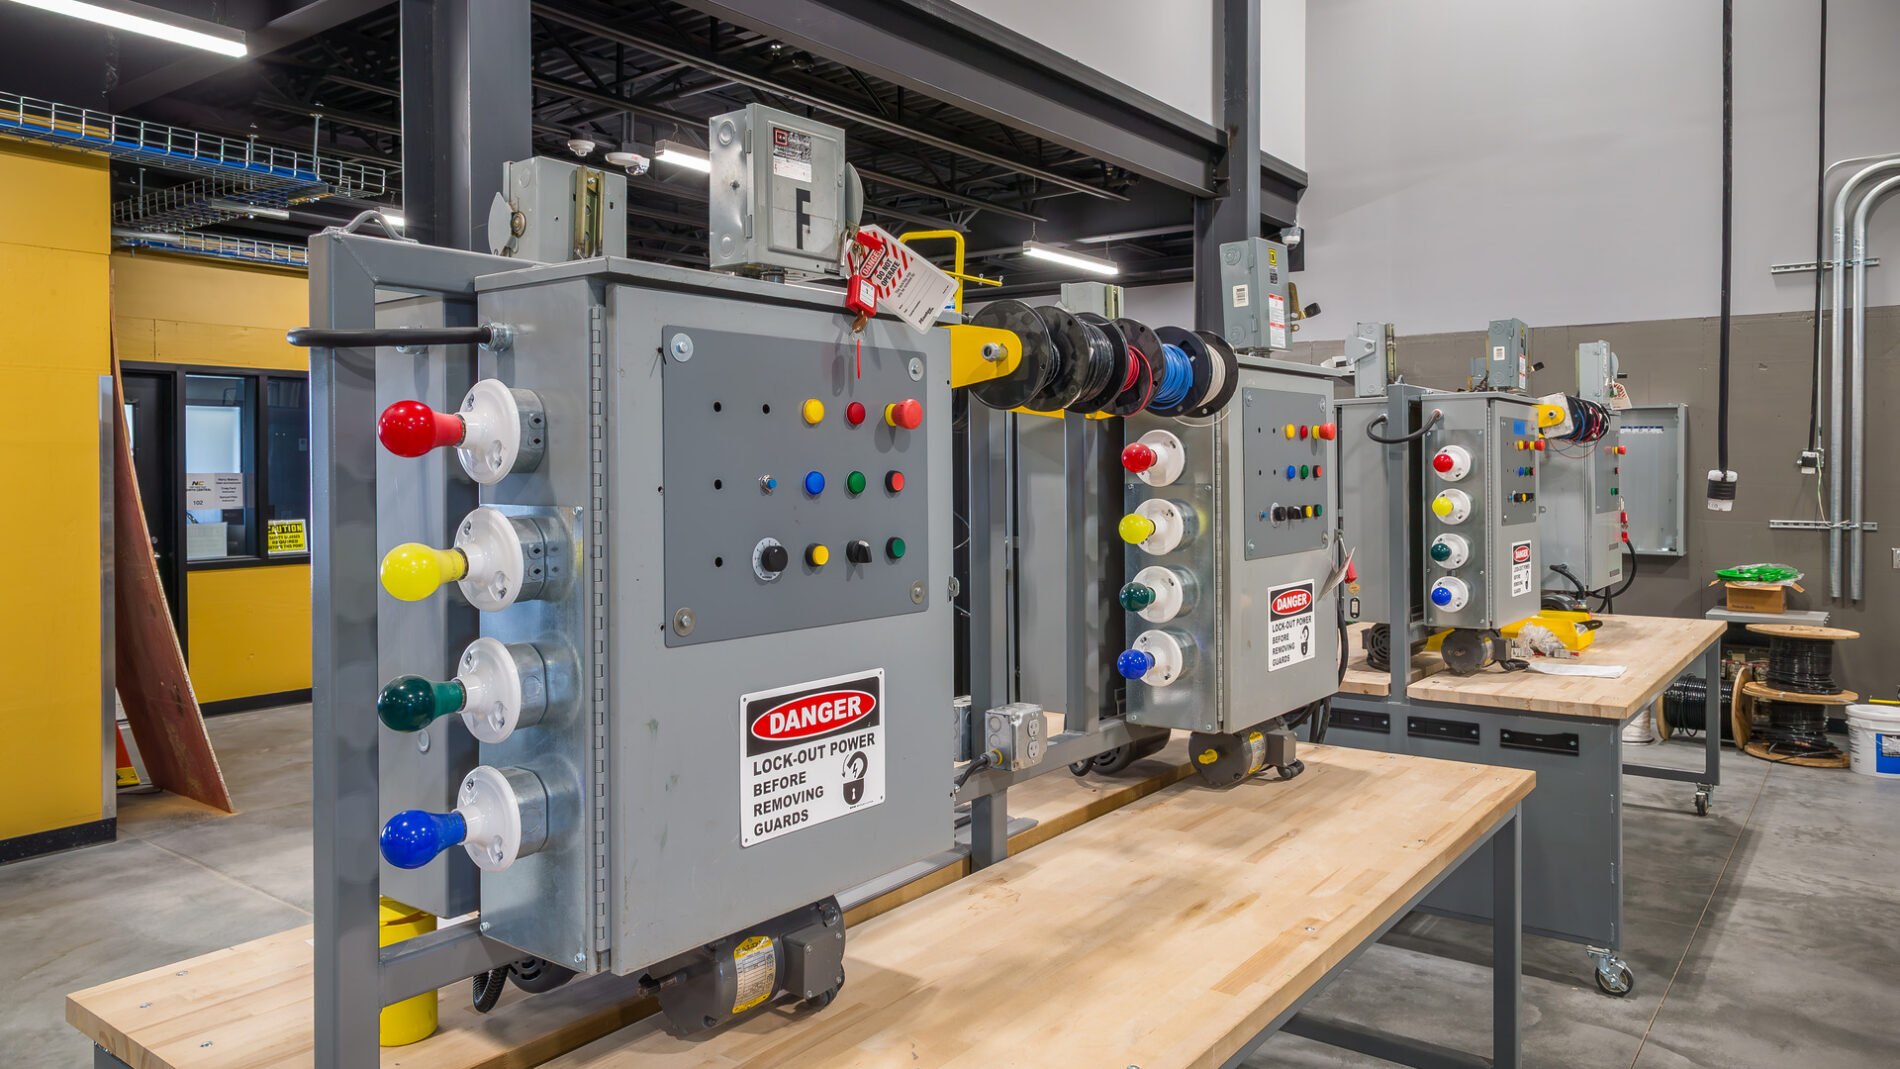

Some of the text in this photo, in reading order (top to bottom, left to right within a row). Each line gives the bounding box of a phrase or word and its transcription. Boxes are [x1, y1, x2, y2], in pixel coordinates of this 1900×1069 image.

[795, 187, 811, 250] F
[876, 258, 893, 281] DO NOT
[880, 261, 900, 287] OPERATE
[1277, 594, 1307, 611] DANGER
[1272, 615, 1312, 633] LOCK-OUT POWER
[1272, 633, 1289, 645] BEFORE
[1272, 642, 1295, 655] REMOVING
[1272, 654, 1290, 667] GUARDS
[769, 695, 862, 735] DANGER
[753, 732, 875, 776] LOCK-OUT POWER
[753, 771, 807, 797] BEFORE
[753, 785, 824, 817] REMOVING
[754, 809, 809, 837] GUARDS
